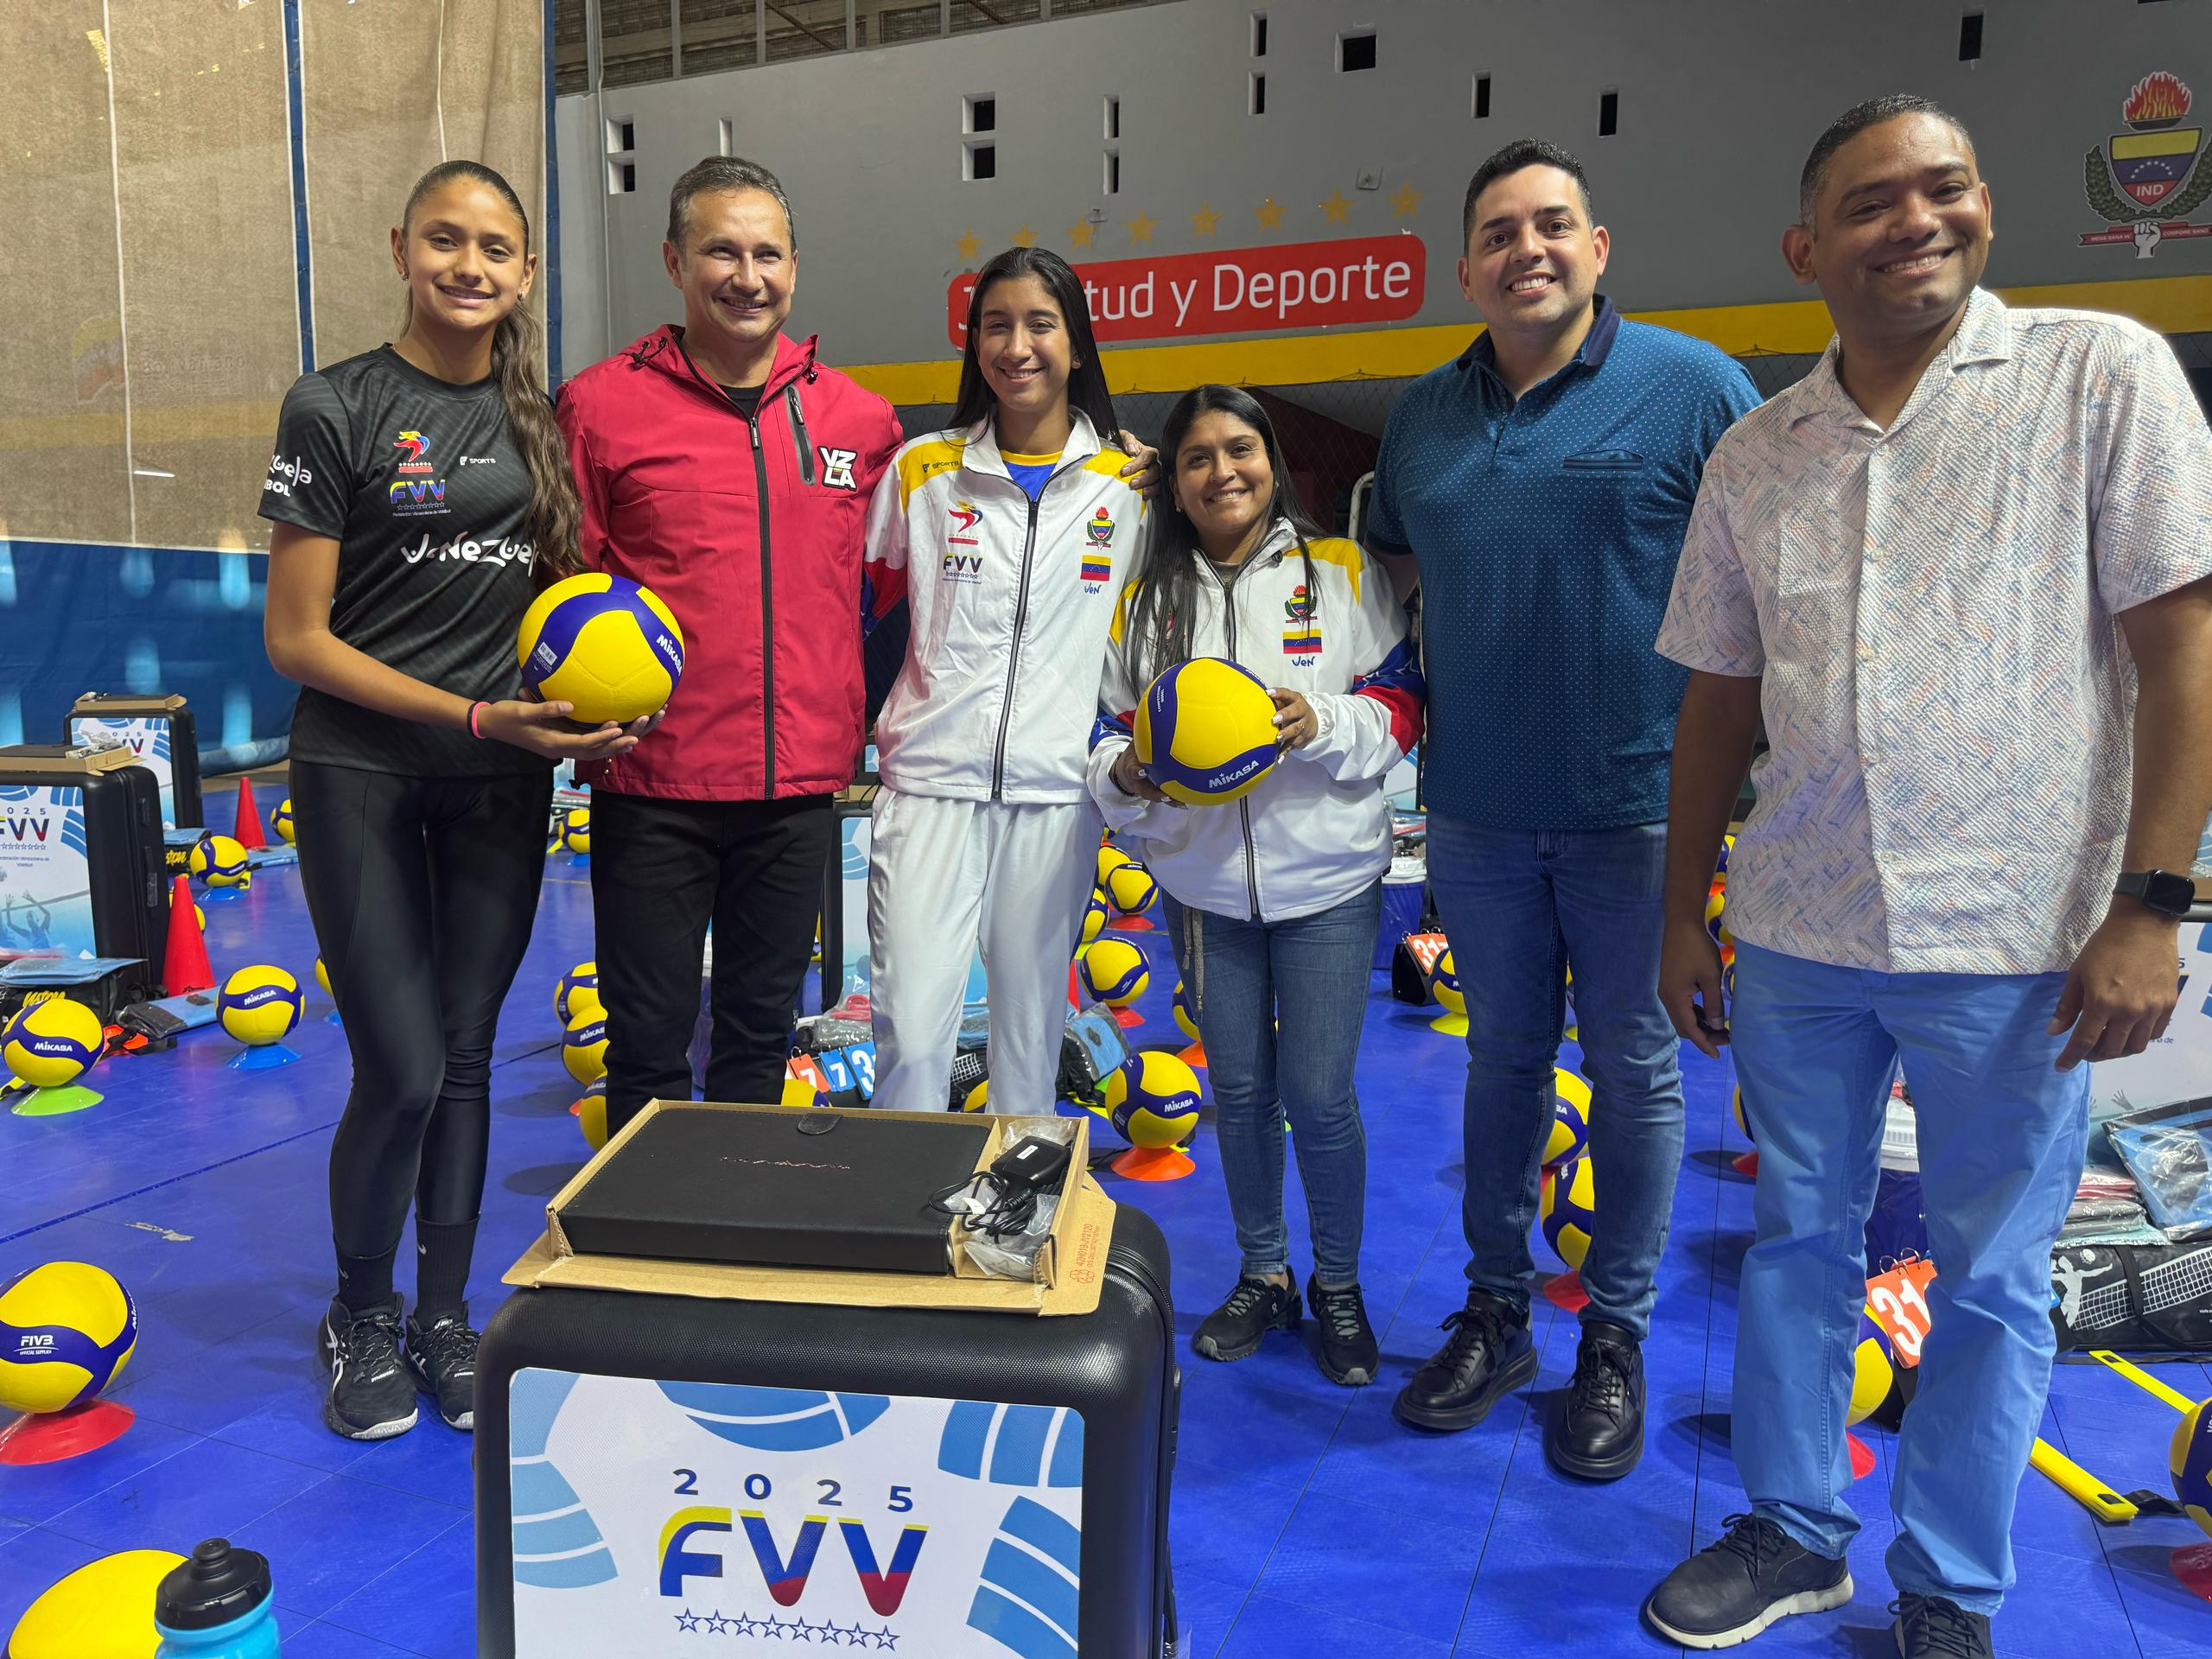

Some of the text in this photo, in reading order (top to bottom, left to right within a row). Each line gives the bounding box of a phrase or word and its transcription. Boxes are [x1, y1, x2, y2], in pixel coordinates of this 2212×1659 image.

[2136, 184, 2164, 196] IND
[1170, 279, 1198, 327] y
[1214, 255, 1411, 321] Deporte
[390, 479, 446, 504] FVV
[943, 553, 982, 573] FVV
[830, 1050, 876, 1092] 7 3
[658, 1505, 930, 1617] FVV
